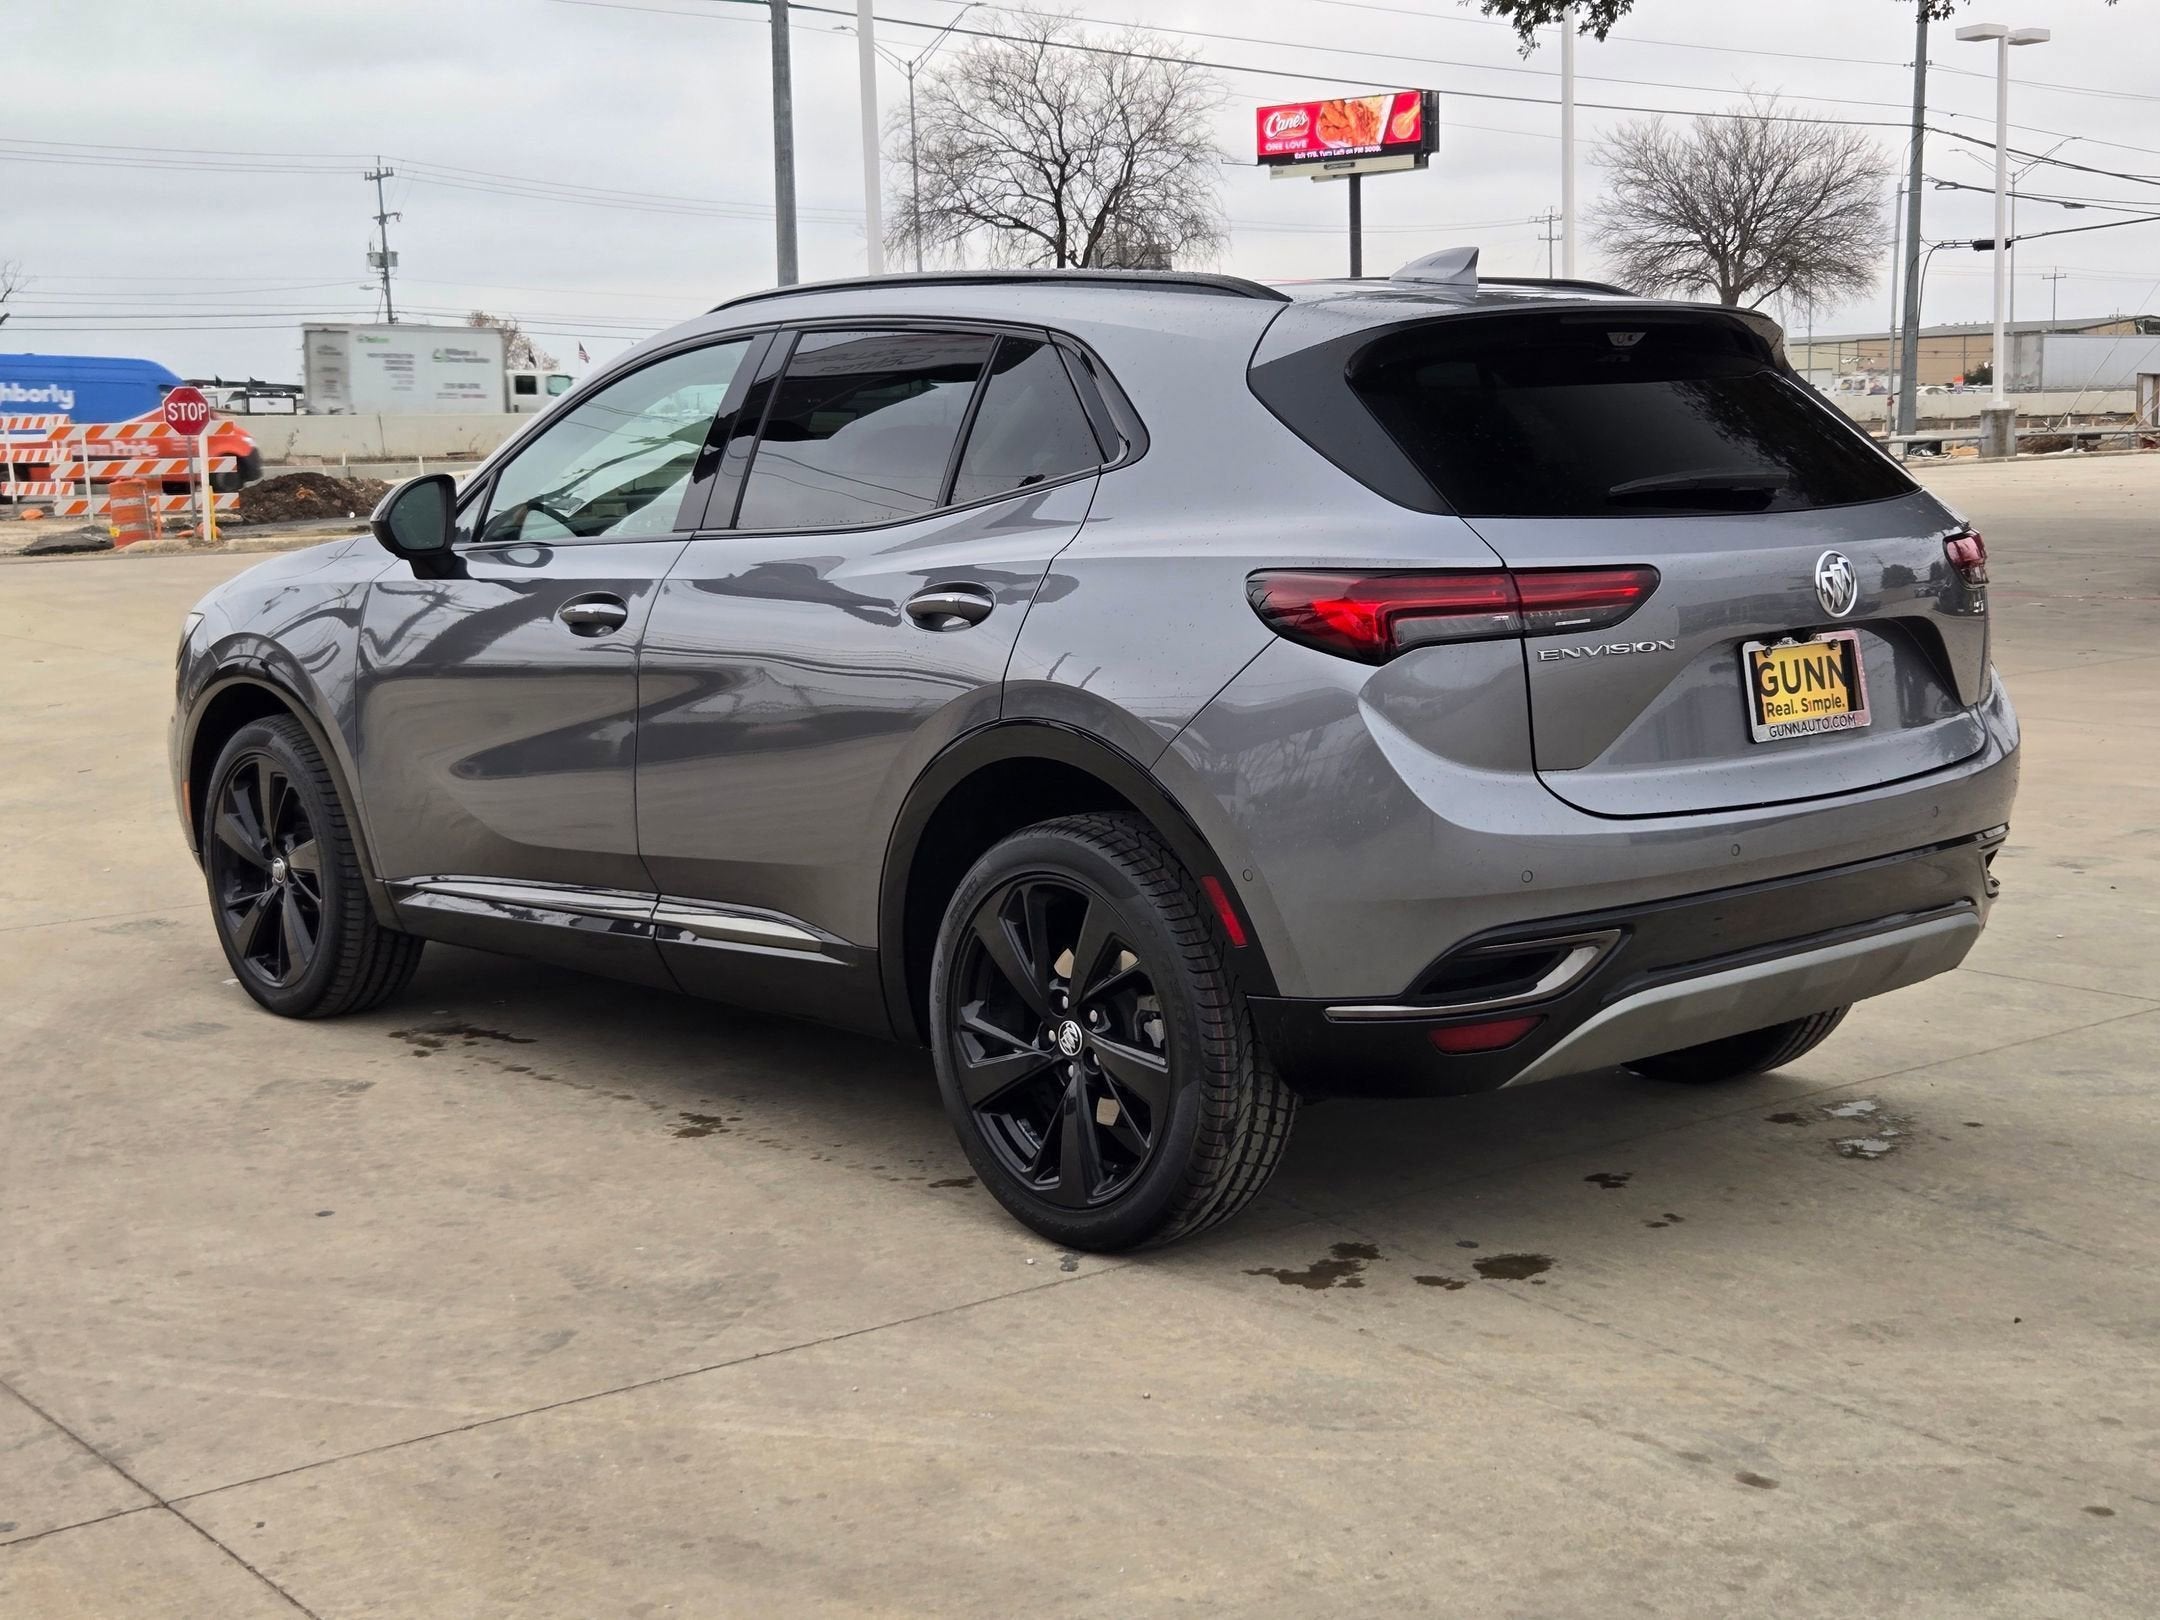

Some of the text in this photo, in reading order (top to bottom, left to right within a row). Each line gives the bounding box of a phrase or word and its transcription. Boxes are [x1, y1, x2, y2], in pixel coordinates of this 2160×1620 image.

[1265, 110, 1308, 138] Cane's
[1265, 140, 1308, 151] ONE LOVE
[168, 402, 207, 421] STOP
[1538, 639, 1675, 662] ENVISION
[1757, 655, 1848, 698] GUNN
[1765, 701, 1798, 718] Real.
[1769, 713, 1857, 739] GUNNAUTO.COM
